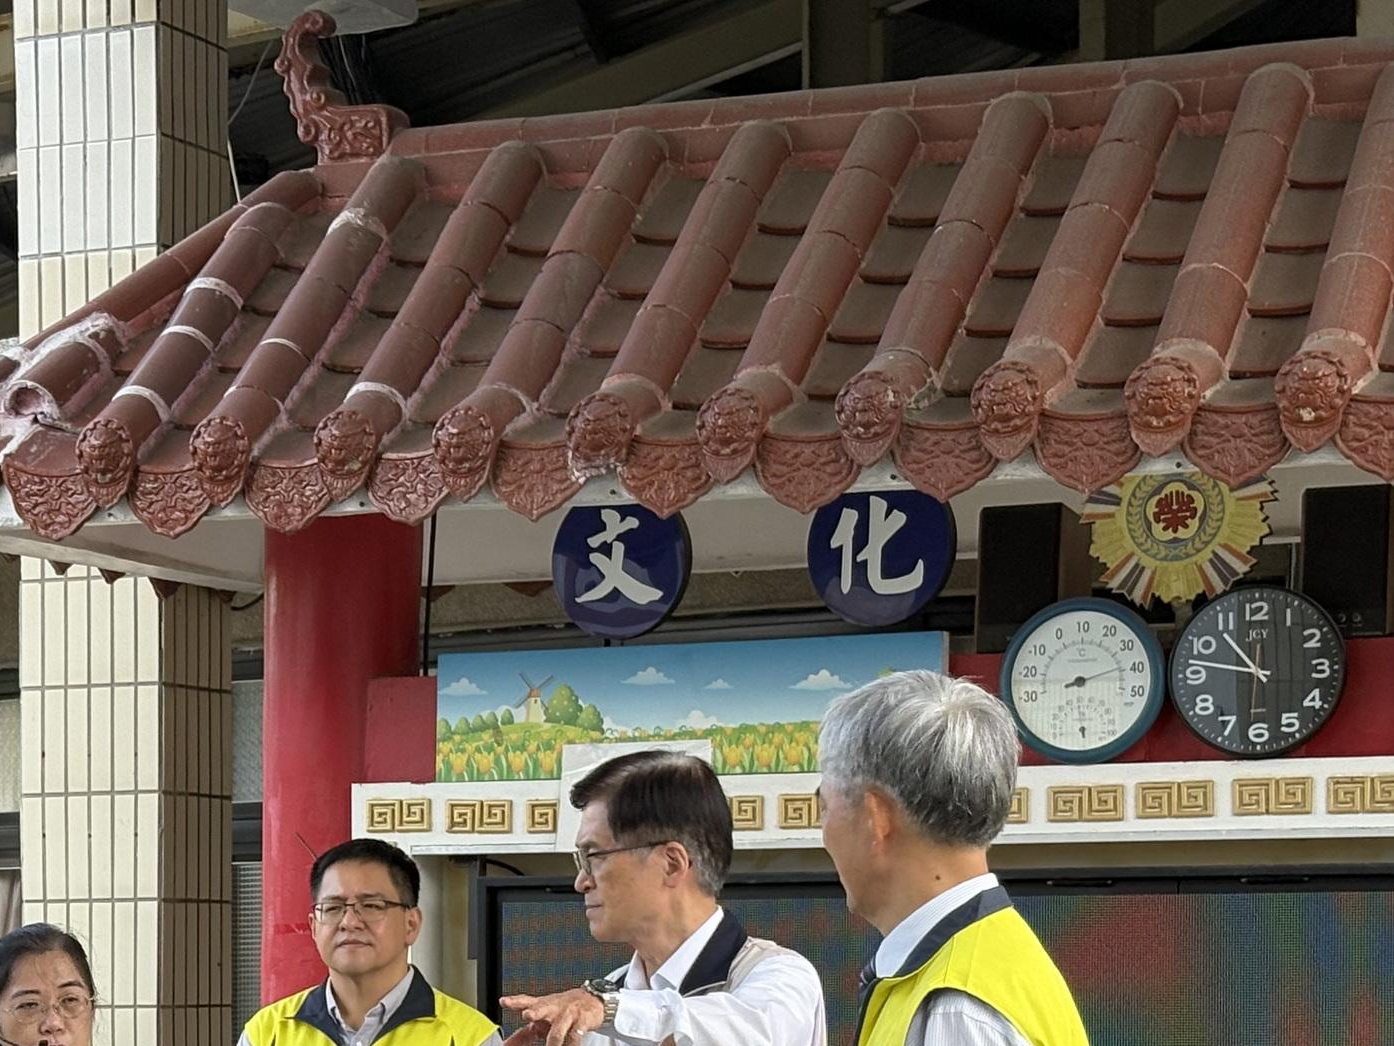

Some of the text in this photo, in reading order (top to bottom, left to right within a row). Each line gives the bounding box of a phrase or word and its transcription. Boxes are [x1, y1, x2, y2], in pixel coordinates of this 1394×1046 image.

[1218, 611, 1234, 631] 11
[1245, 601, 1269, 621] 12
[1055, 628, 1063, 640] 0
[1076, 620, 1090, 633] 10
[1102, 624, 1117, 637] 20
[1119, 639, 1134, 651] 30
[1192, 635, 1216, 655] 10
[1302, 628, 1321, 648] 2
[1028, 644, 1046, 656] -10
[1018, 666, 1037, 678] -20
[1129, 661, 1145, 674] 40
[1185, 665, 1206, 685] 9
[1311, 658, 1330, 679] 3
[1130, 685, 1145, 698] 50
[1302, 688, 1323, 709] 4
[1195, 694, 1215, 715] 8
[1218, 715, 1237, 736] 7
[1280, 712, 1300, 733] 5
[1248, 723, 1269, 743] 6
